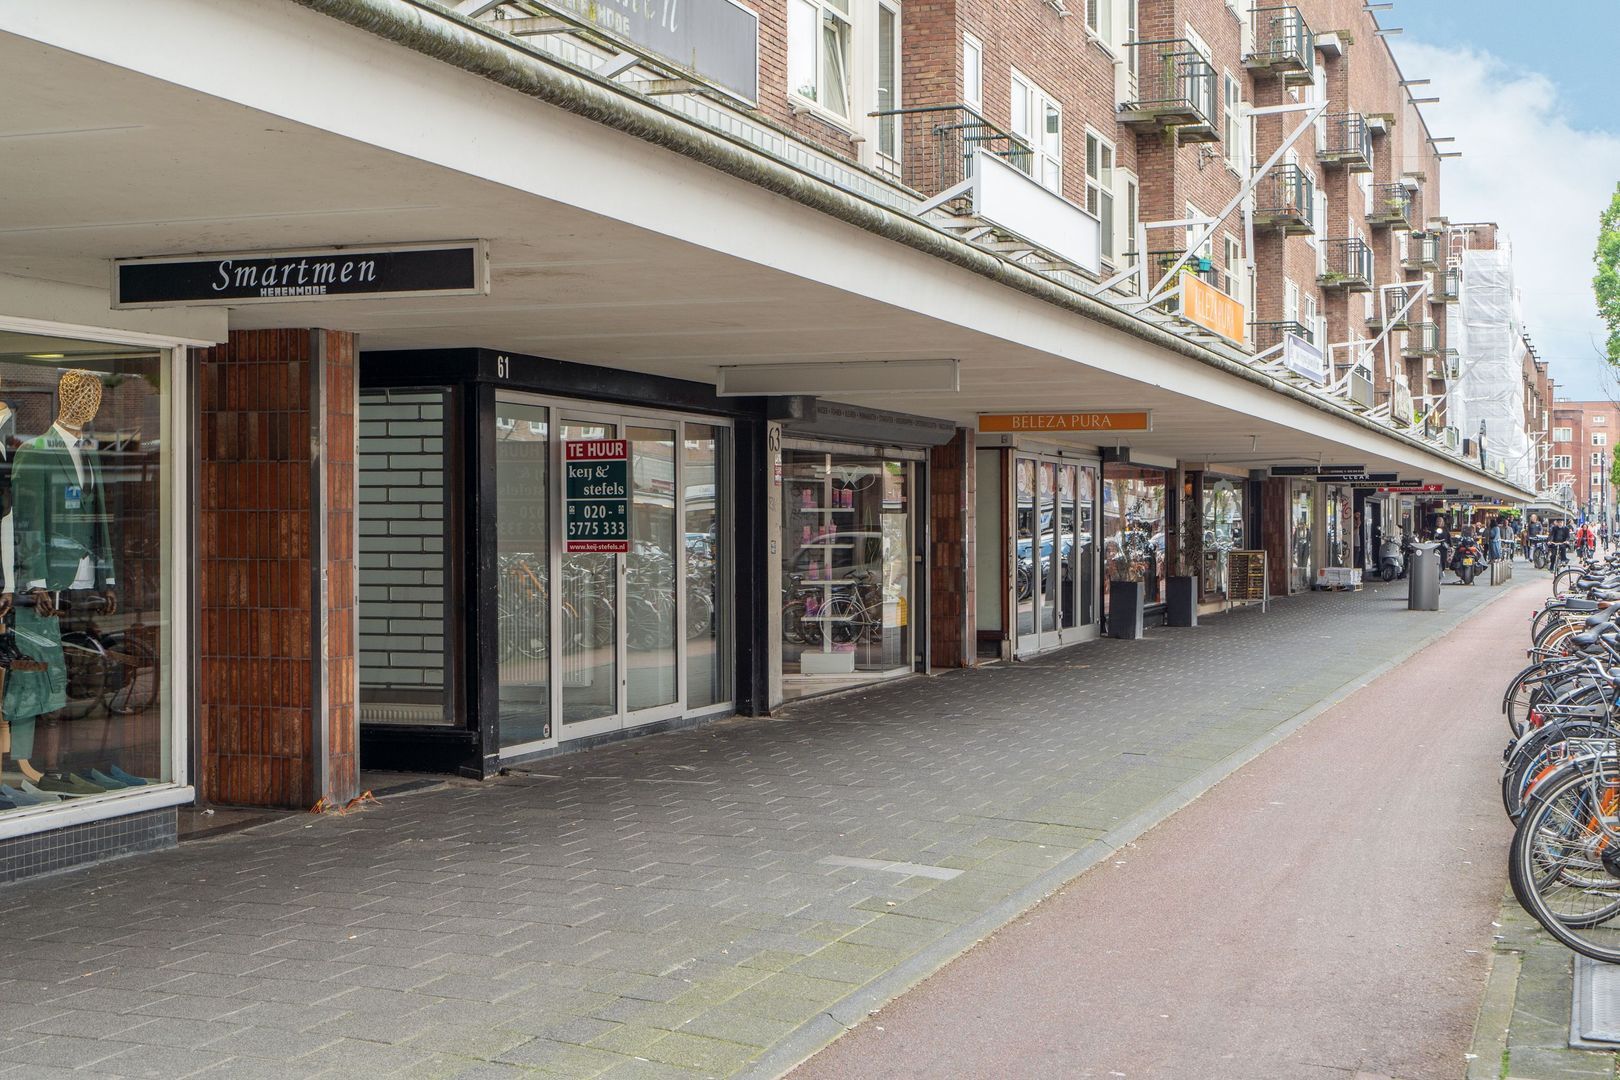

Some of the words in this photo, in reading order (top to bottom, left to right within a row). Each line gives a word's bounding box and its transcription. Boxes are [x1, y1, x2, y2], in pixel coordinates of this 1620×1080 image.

[212, 259, 377, 291] Smartmen
[260, 285, 327, 297] HERENMODE
[497, 355, 510, 379] 61
[1012, 414, 1067, 429] BELEZA
[1071, 414, 1112, 428] PURA
[768, 427, 781, 452] 63
[568, 443, 584, 457] TE
[587, 442, 624, 457] HUUR
[595, 464, 610, 478] &
[583, 482, 625, 496] stefels
[569, 521, 599, 536] 5775
[602, 521, 625, 535] 333
[569, 543, 626, 551] www.keij-stefels.nl
